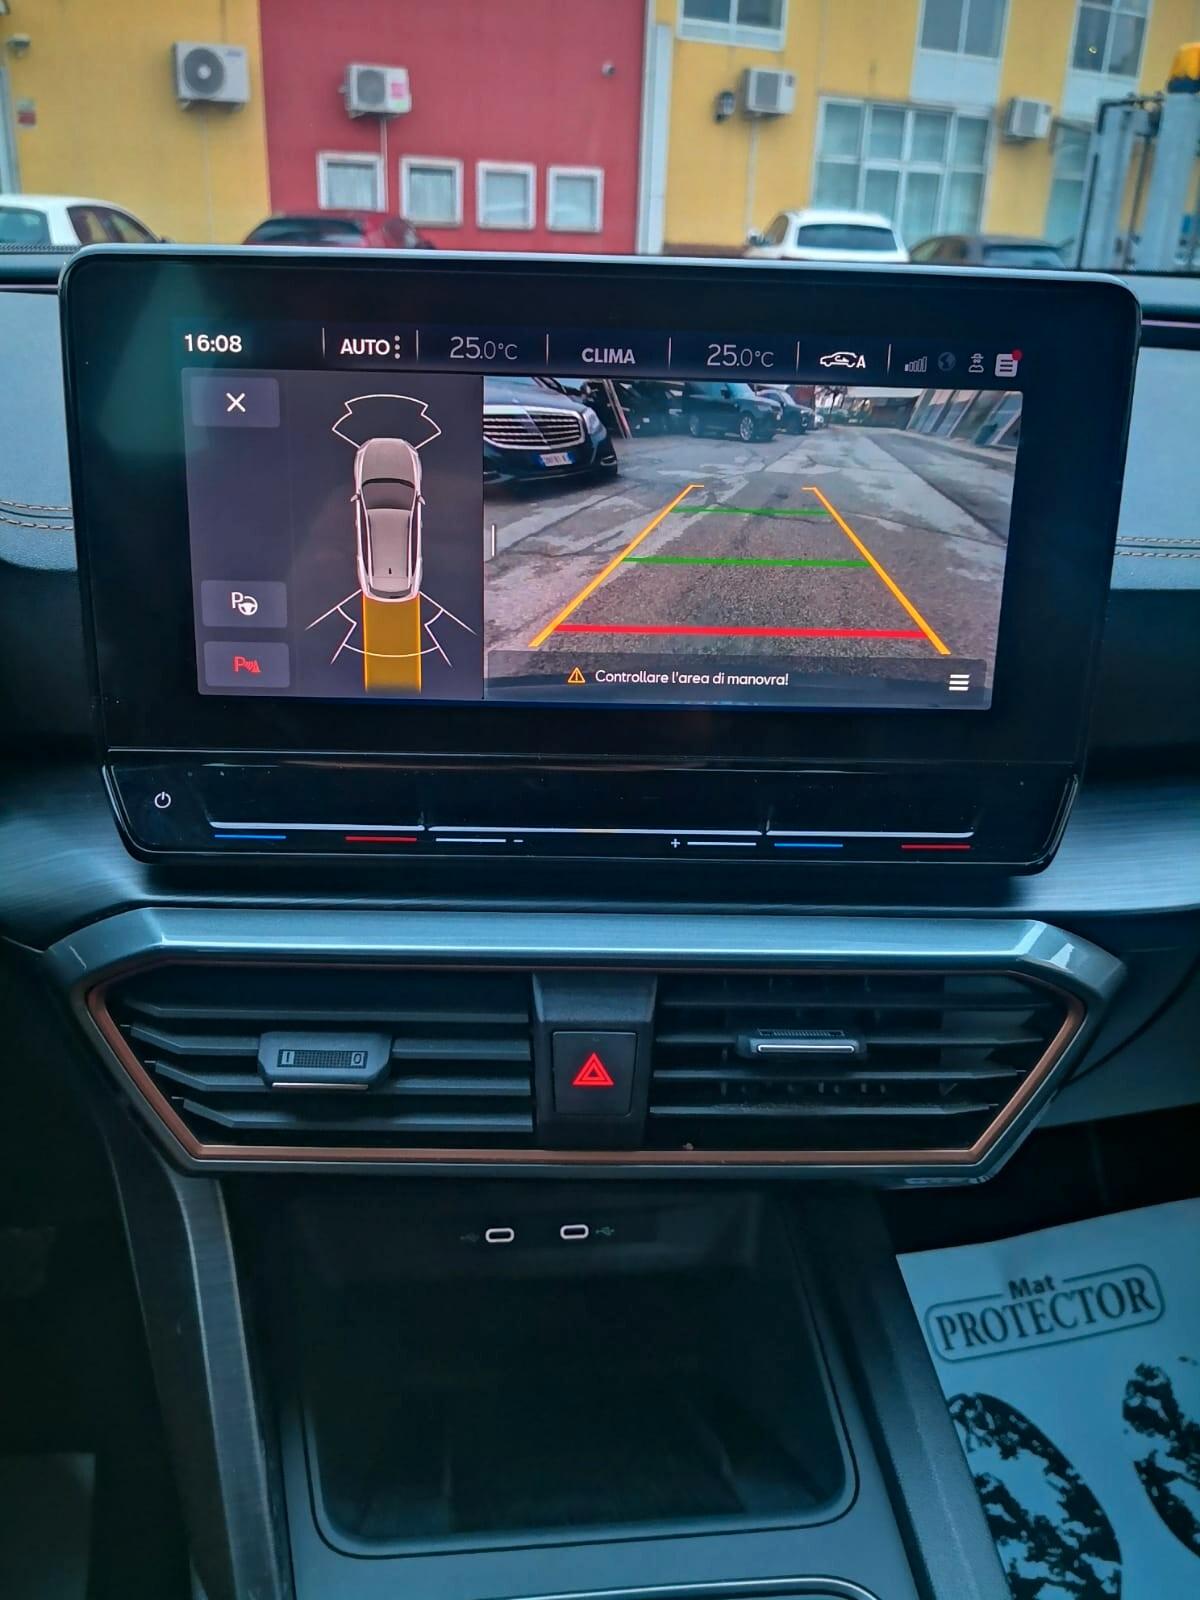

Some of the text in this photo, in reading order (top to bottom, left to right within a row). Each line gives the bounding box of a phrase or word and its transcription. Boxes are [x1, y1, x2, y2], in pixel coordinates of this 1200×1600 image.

[184, 334, 243, 353] 16:08
[340, 338, 391, 356] AUTO
[581, 348, 636, 365] CLIMA
[595, 669, 789, 686] Controllare l'area di manovra!
[1008, 1276, 1055, 1299] Mat
[935, 1276, 1156, 1351] PROTECTOR
